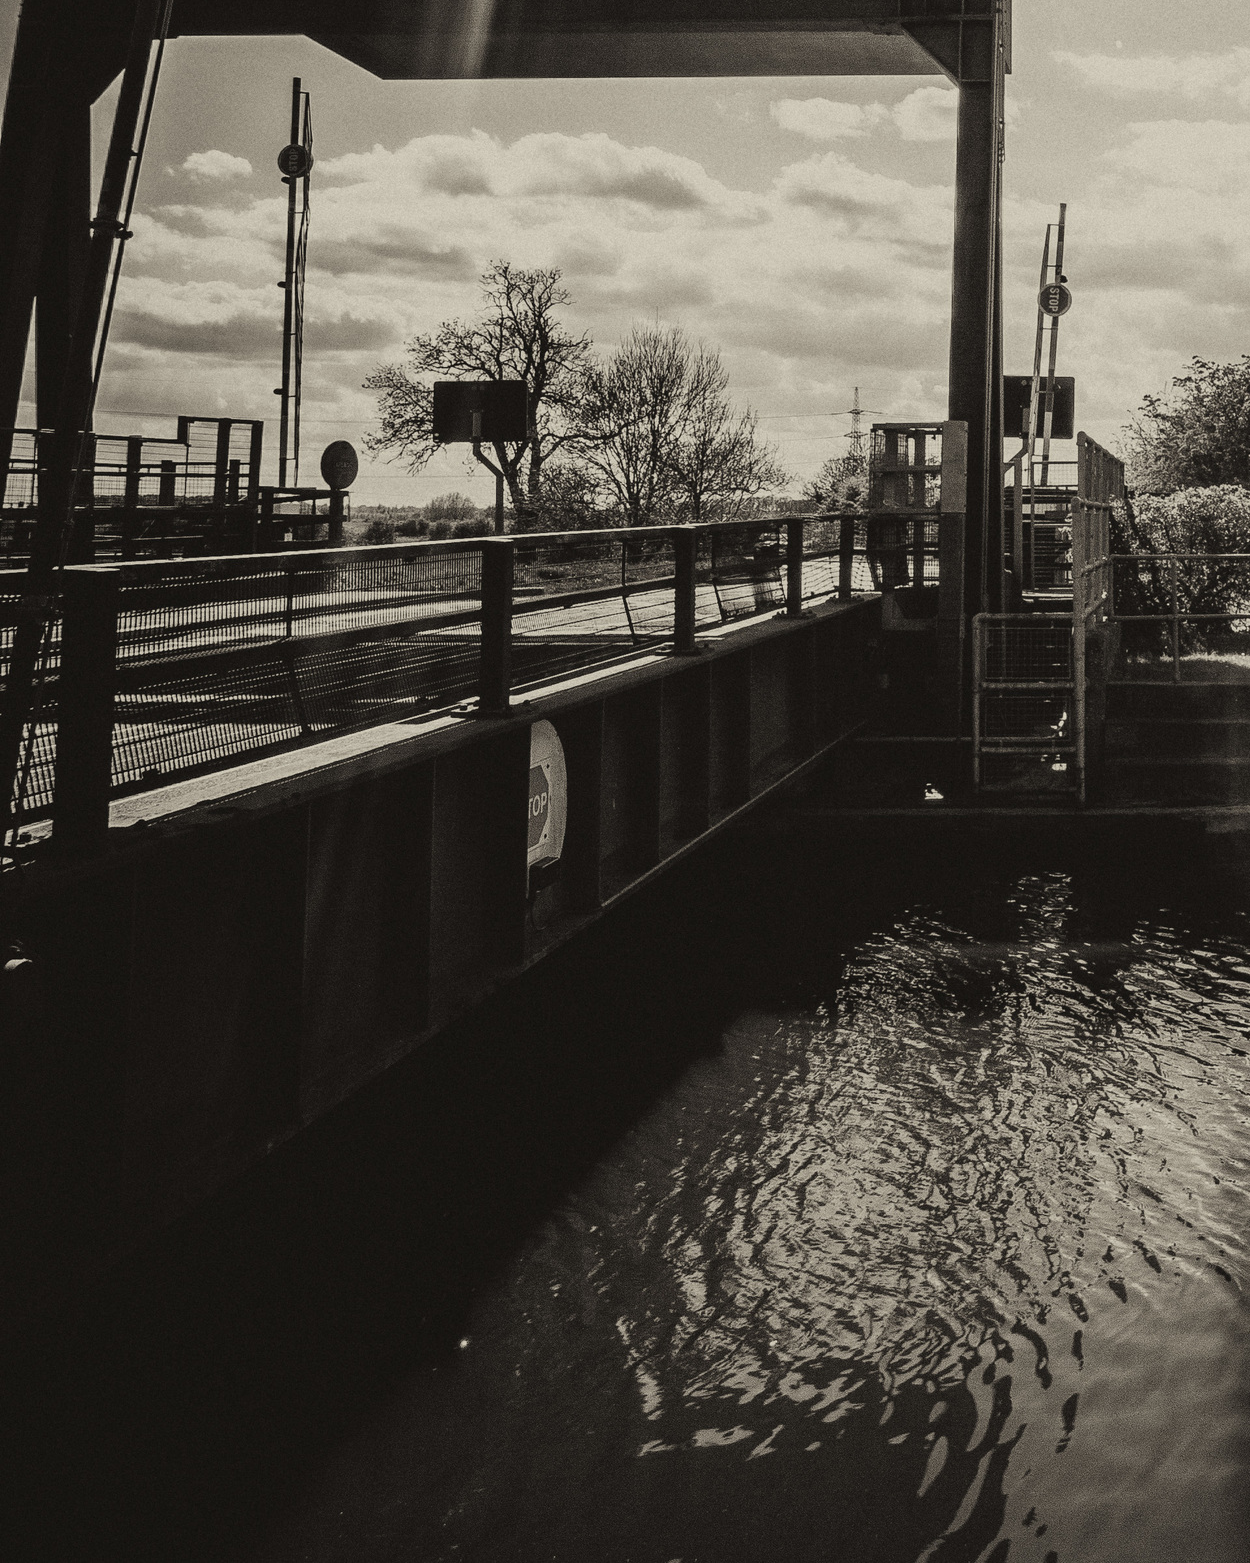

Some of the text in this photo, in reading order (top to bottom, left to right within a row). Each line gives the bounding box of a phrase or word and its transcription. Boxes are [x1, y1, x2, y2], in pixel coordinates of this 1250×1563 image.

[288, 148, 299, 171] STOP
[1048, 287, 1060, 312] STOP
[528, 792, 547, 819] TOP
